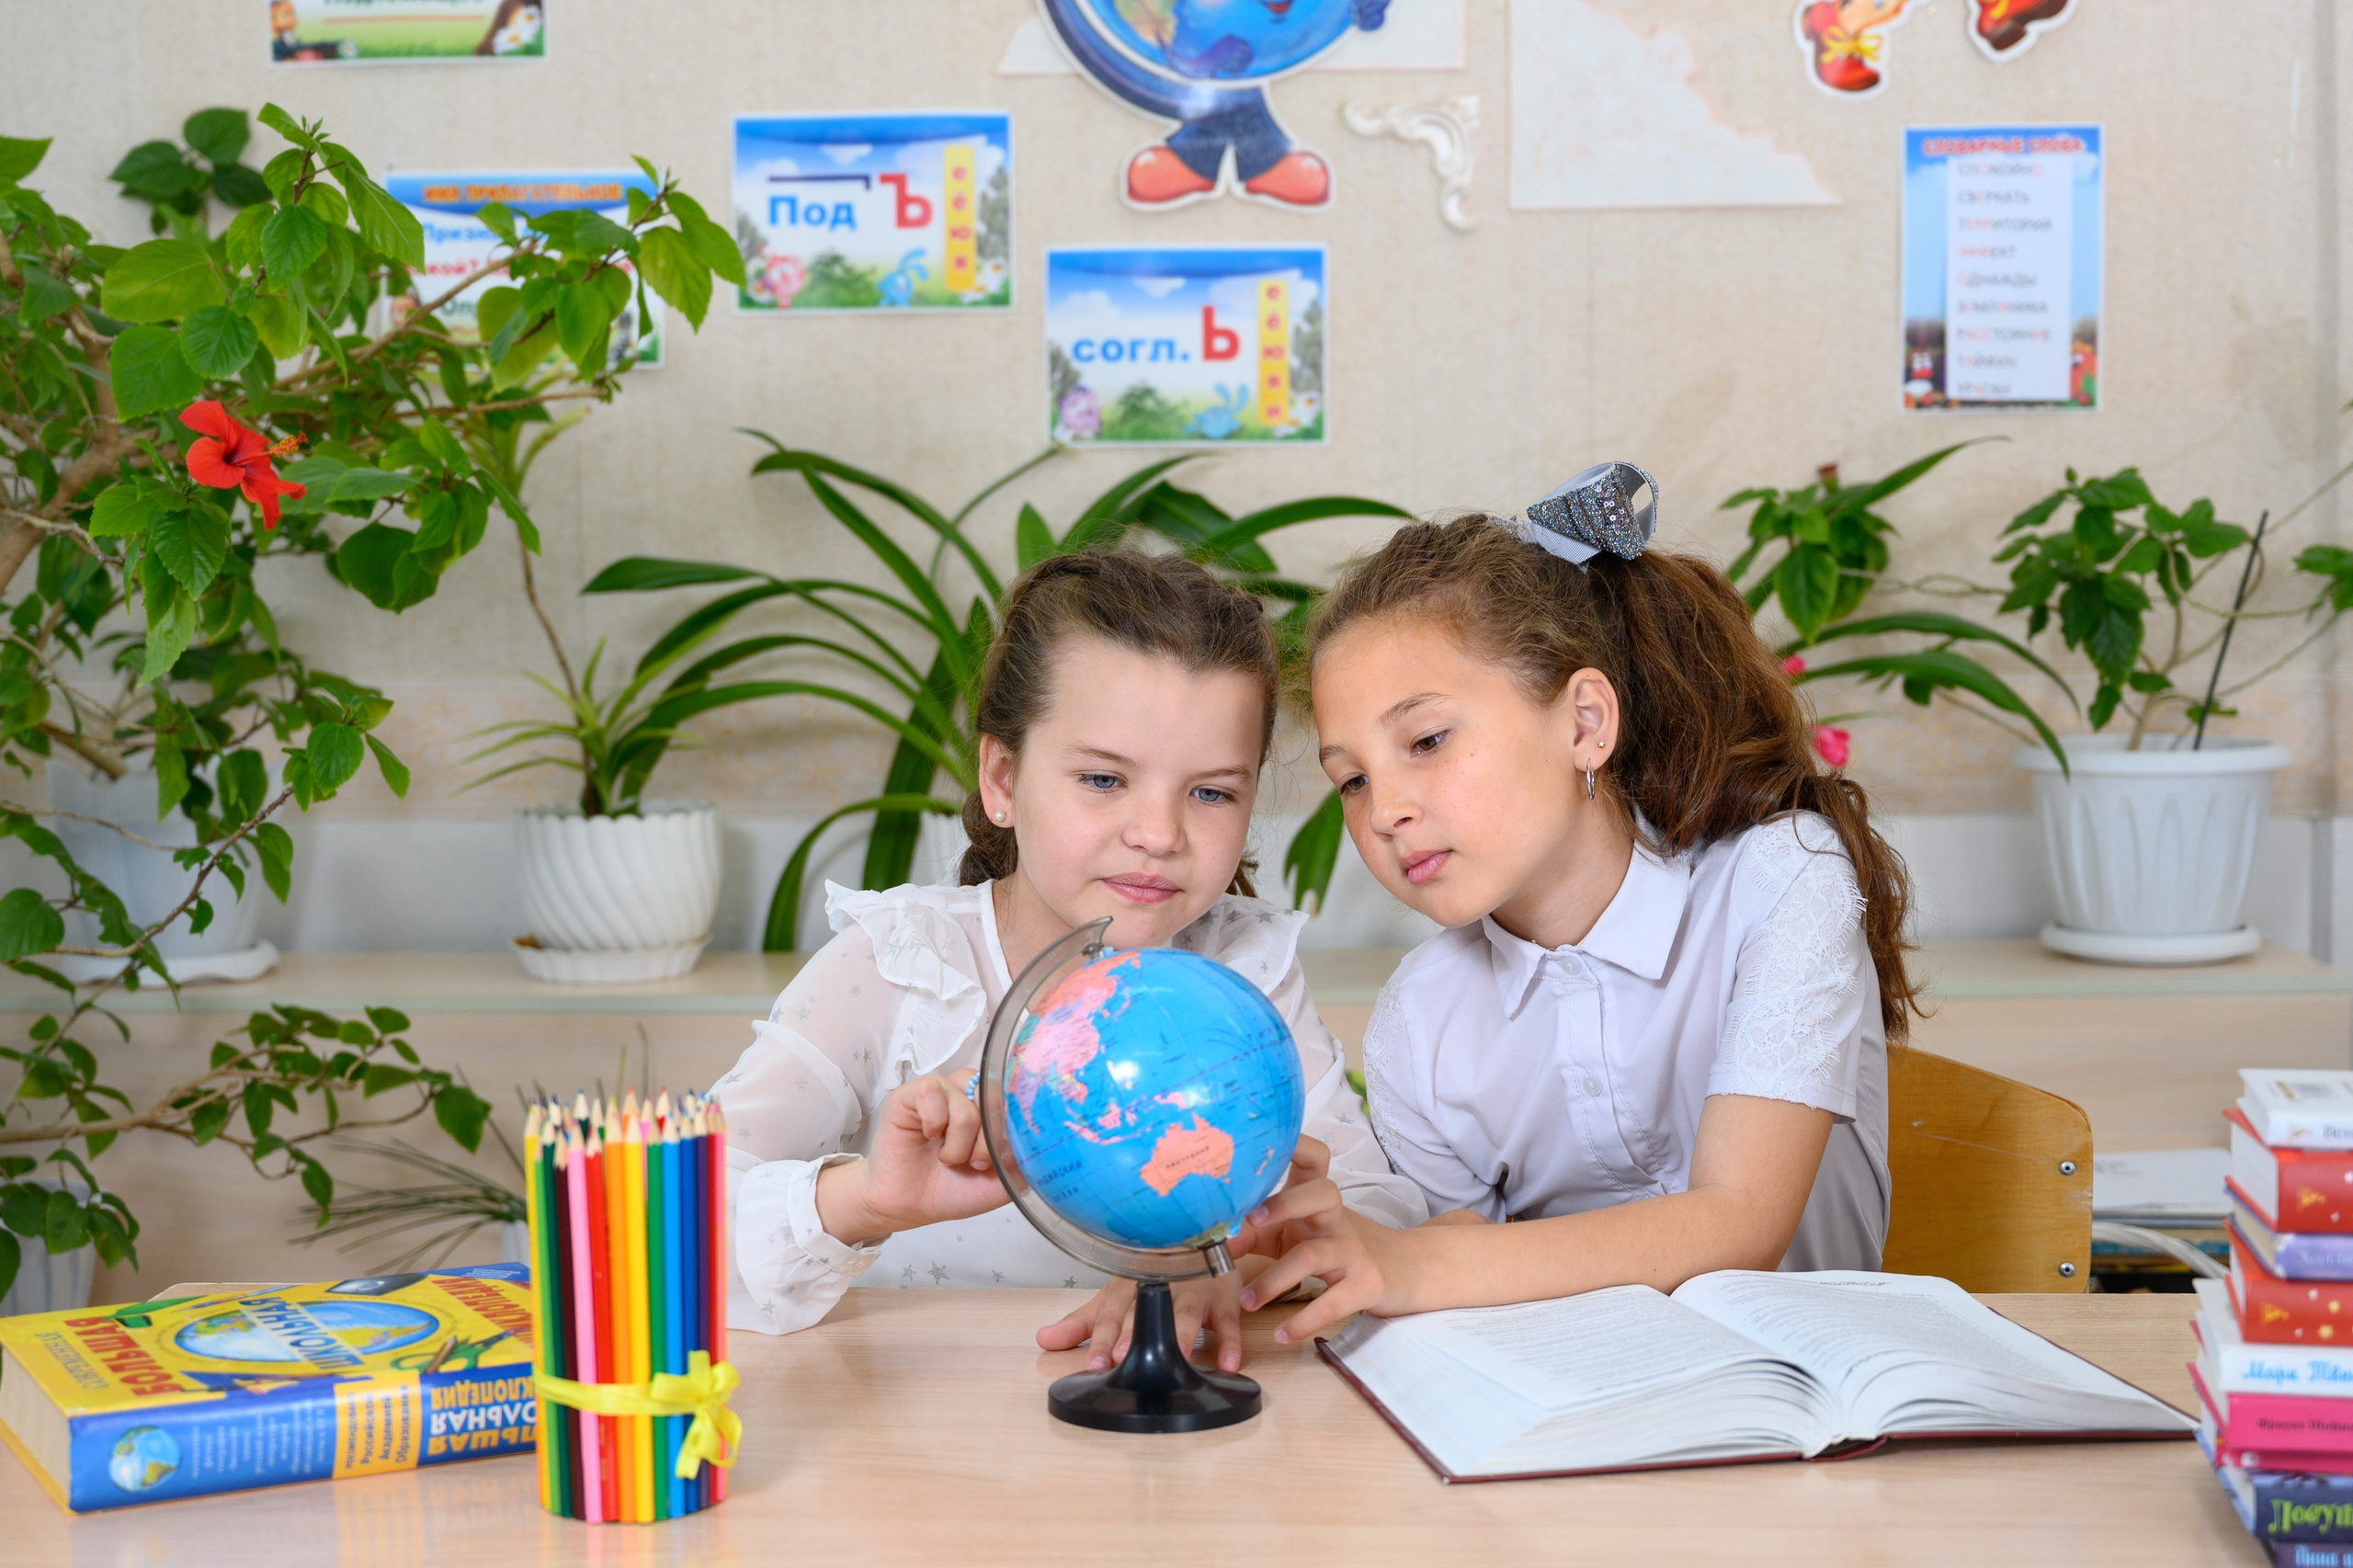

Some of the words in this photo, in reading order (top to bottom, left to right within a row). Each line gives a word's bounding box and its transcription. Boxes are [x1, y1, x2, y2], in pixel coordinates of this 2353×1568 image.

[768, 195, 857, 232] Под
[879, 173, 934, 229] Ъ
[1072, 338, 1190, 362] согл.
[1201, 305, 1241, 362] Ь
[64, 1317, 183, 1396] БОЛЬШАЯ
[238, 1297, 365, 1369] ШКОЛЬНАЯ
[430, 1376, 534, 1411] КЛОПЕДИЯ
[430, 1400, 537, 1436] ОЛЬНАЯ
[427, 1425, 537, 1456] ЛЬШАЯ
